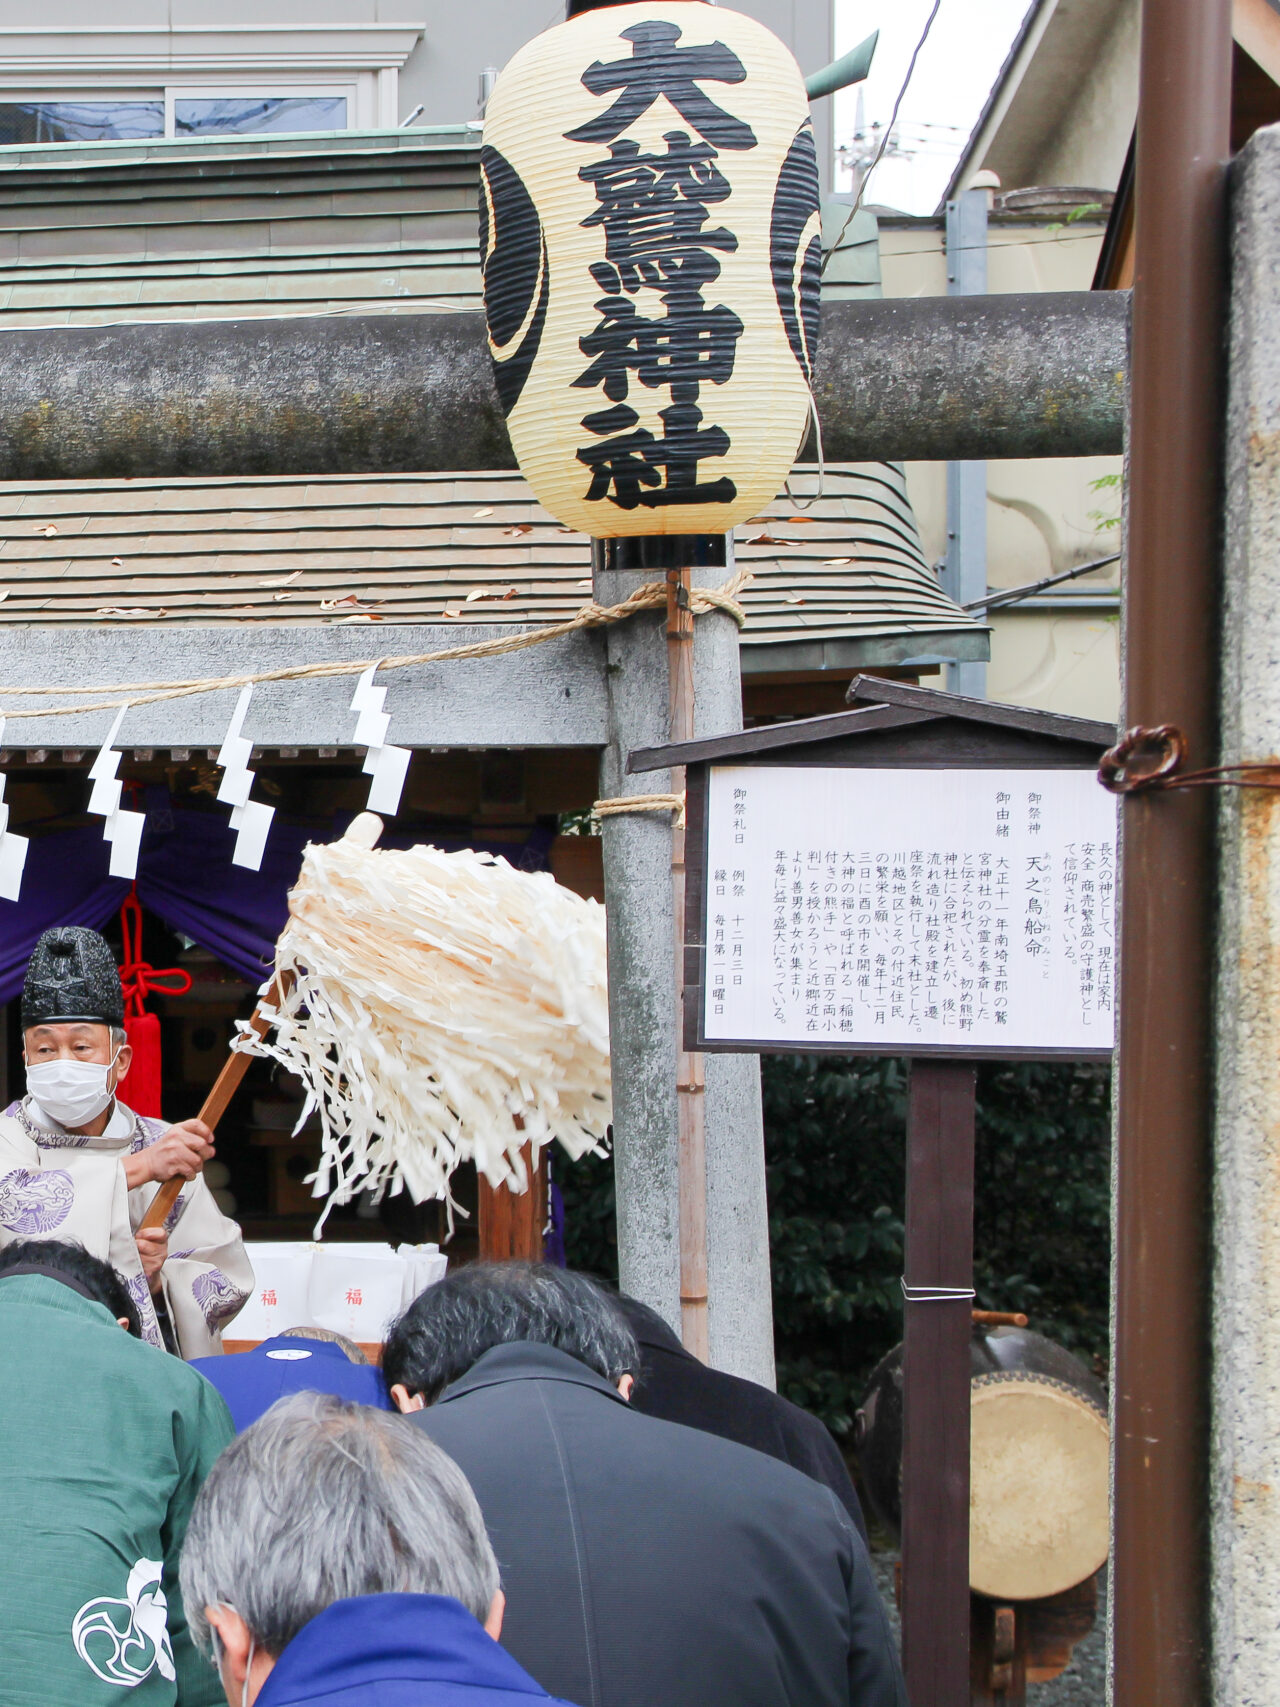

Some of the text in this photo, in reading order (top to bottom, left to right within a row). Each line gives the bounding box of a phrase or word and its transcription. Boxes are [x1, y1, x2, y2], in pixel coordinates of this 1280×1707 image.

[562, 20, 759, 510] 大鷲神社
[261, 1289, 277, 1306] 福
[345, 1287, 363, 1306] 福
